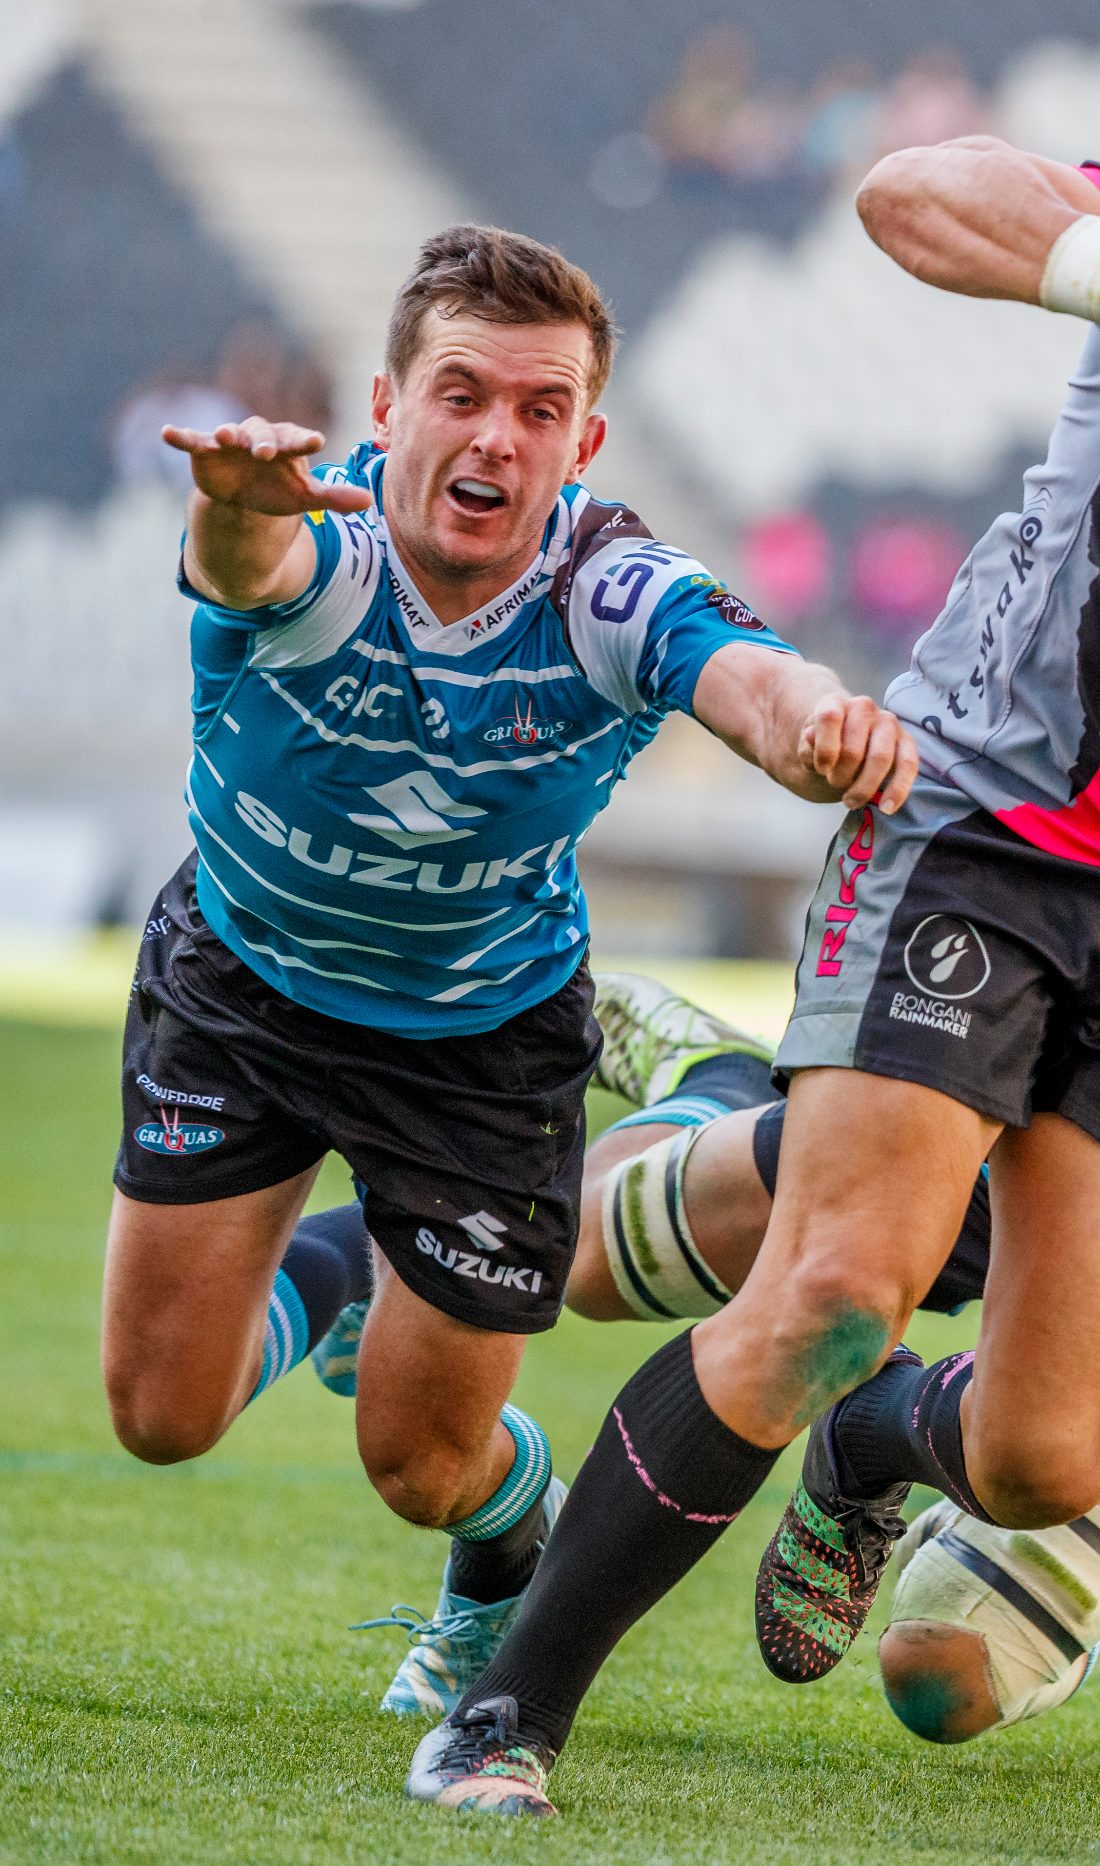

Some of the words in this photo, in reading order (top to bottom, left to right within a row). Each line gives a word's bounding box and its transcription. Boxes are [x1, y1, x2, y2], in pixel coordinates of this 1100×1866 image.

[486, 570, 541, 629] AFRIMA
[234, 790, 570, 894] SUZUKI
[889, 1006, 969, 1039] RAINMAKER
[891, 992, 972, 1028] BONGANI
[138, 1127, 218, 1152] GRIQUAS
[415, 1227, 543, 1294] SUZUKI
